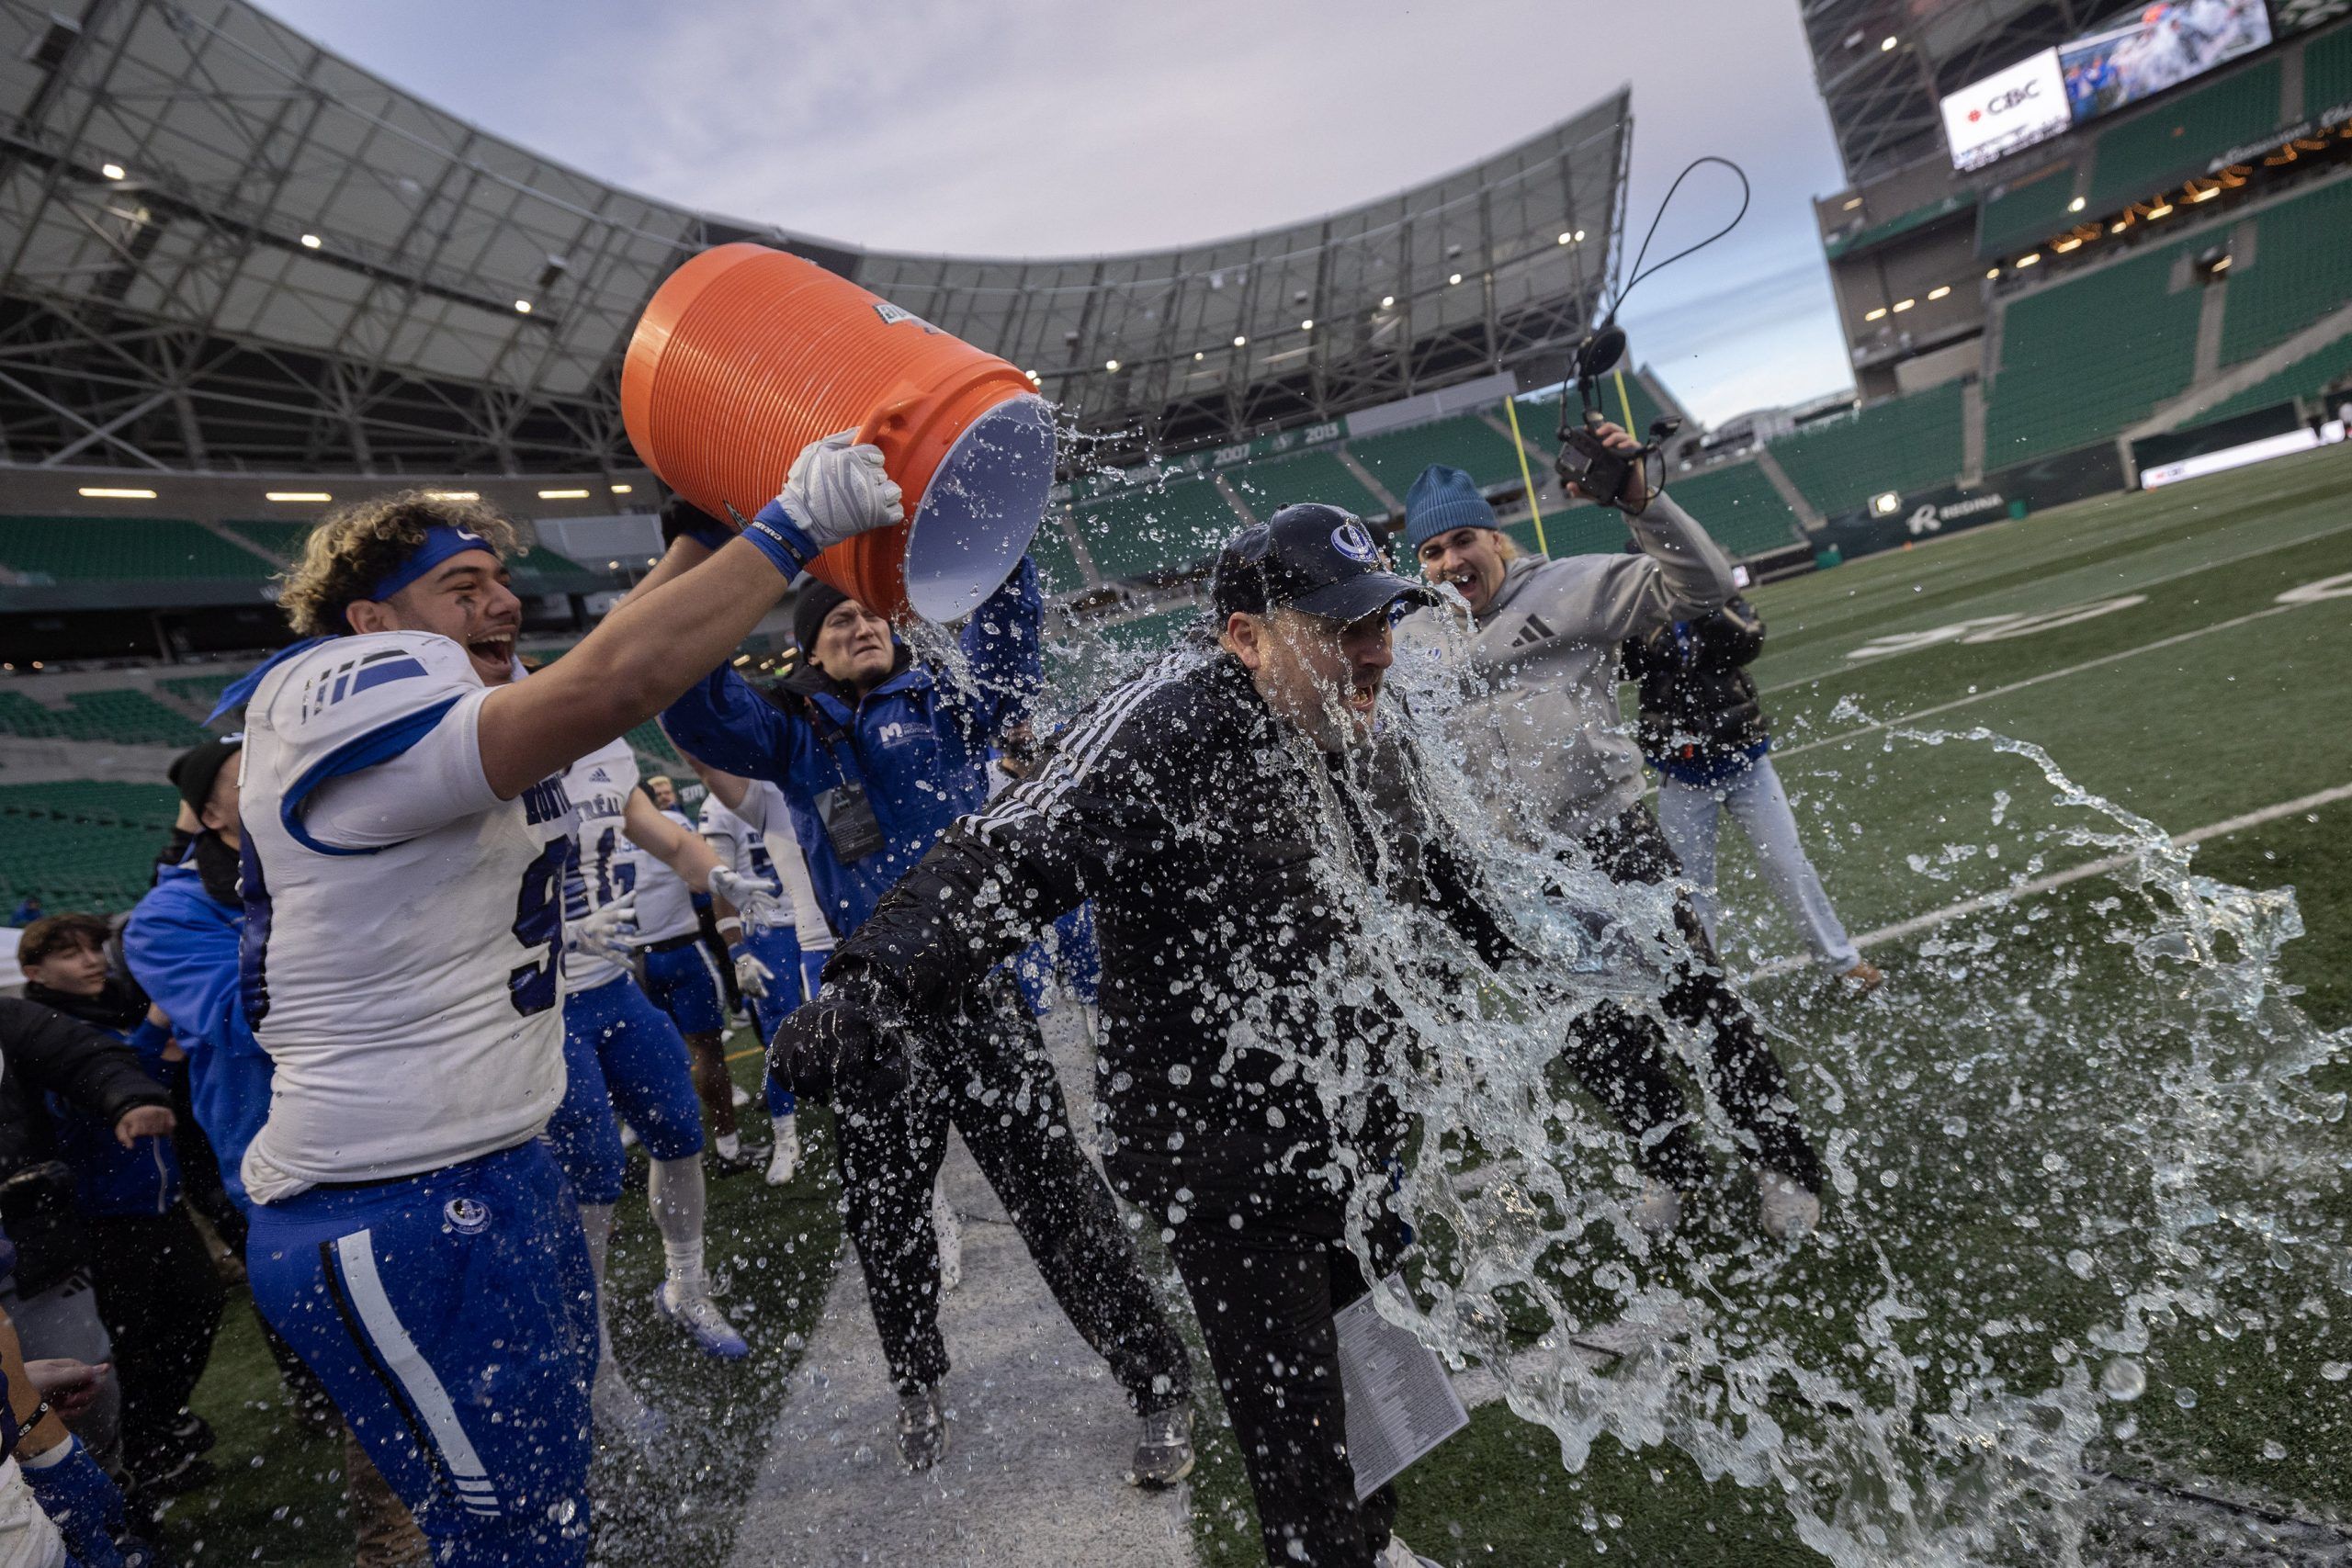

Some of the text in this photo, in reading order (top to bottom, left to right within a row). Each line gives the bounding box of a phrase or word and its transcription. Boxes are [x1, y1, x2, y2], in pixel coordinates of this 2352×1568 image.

[1987, 78, 2040, 115] CBC
[1212, 444, 1250, 466] 2007
[1939, 493, 2003, 521] REGINA
[507, 833, 565, 1018] 9
